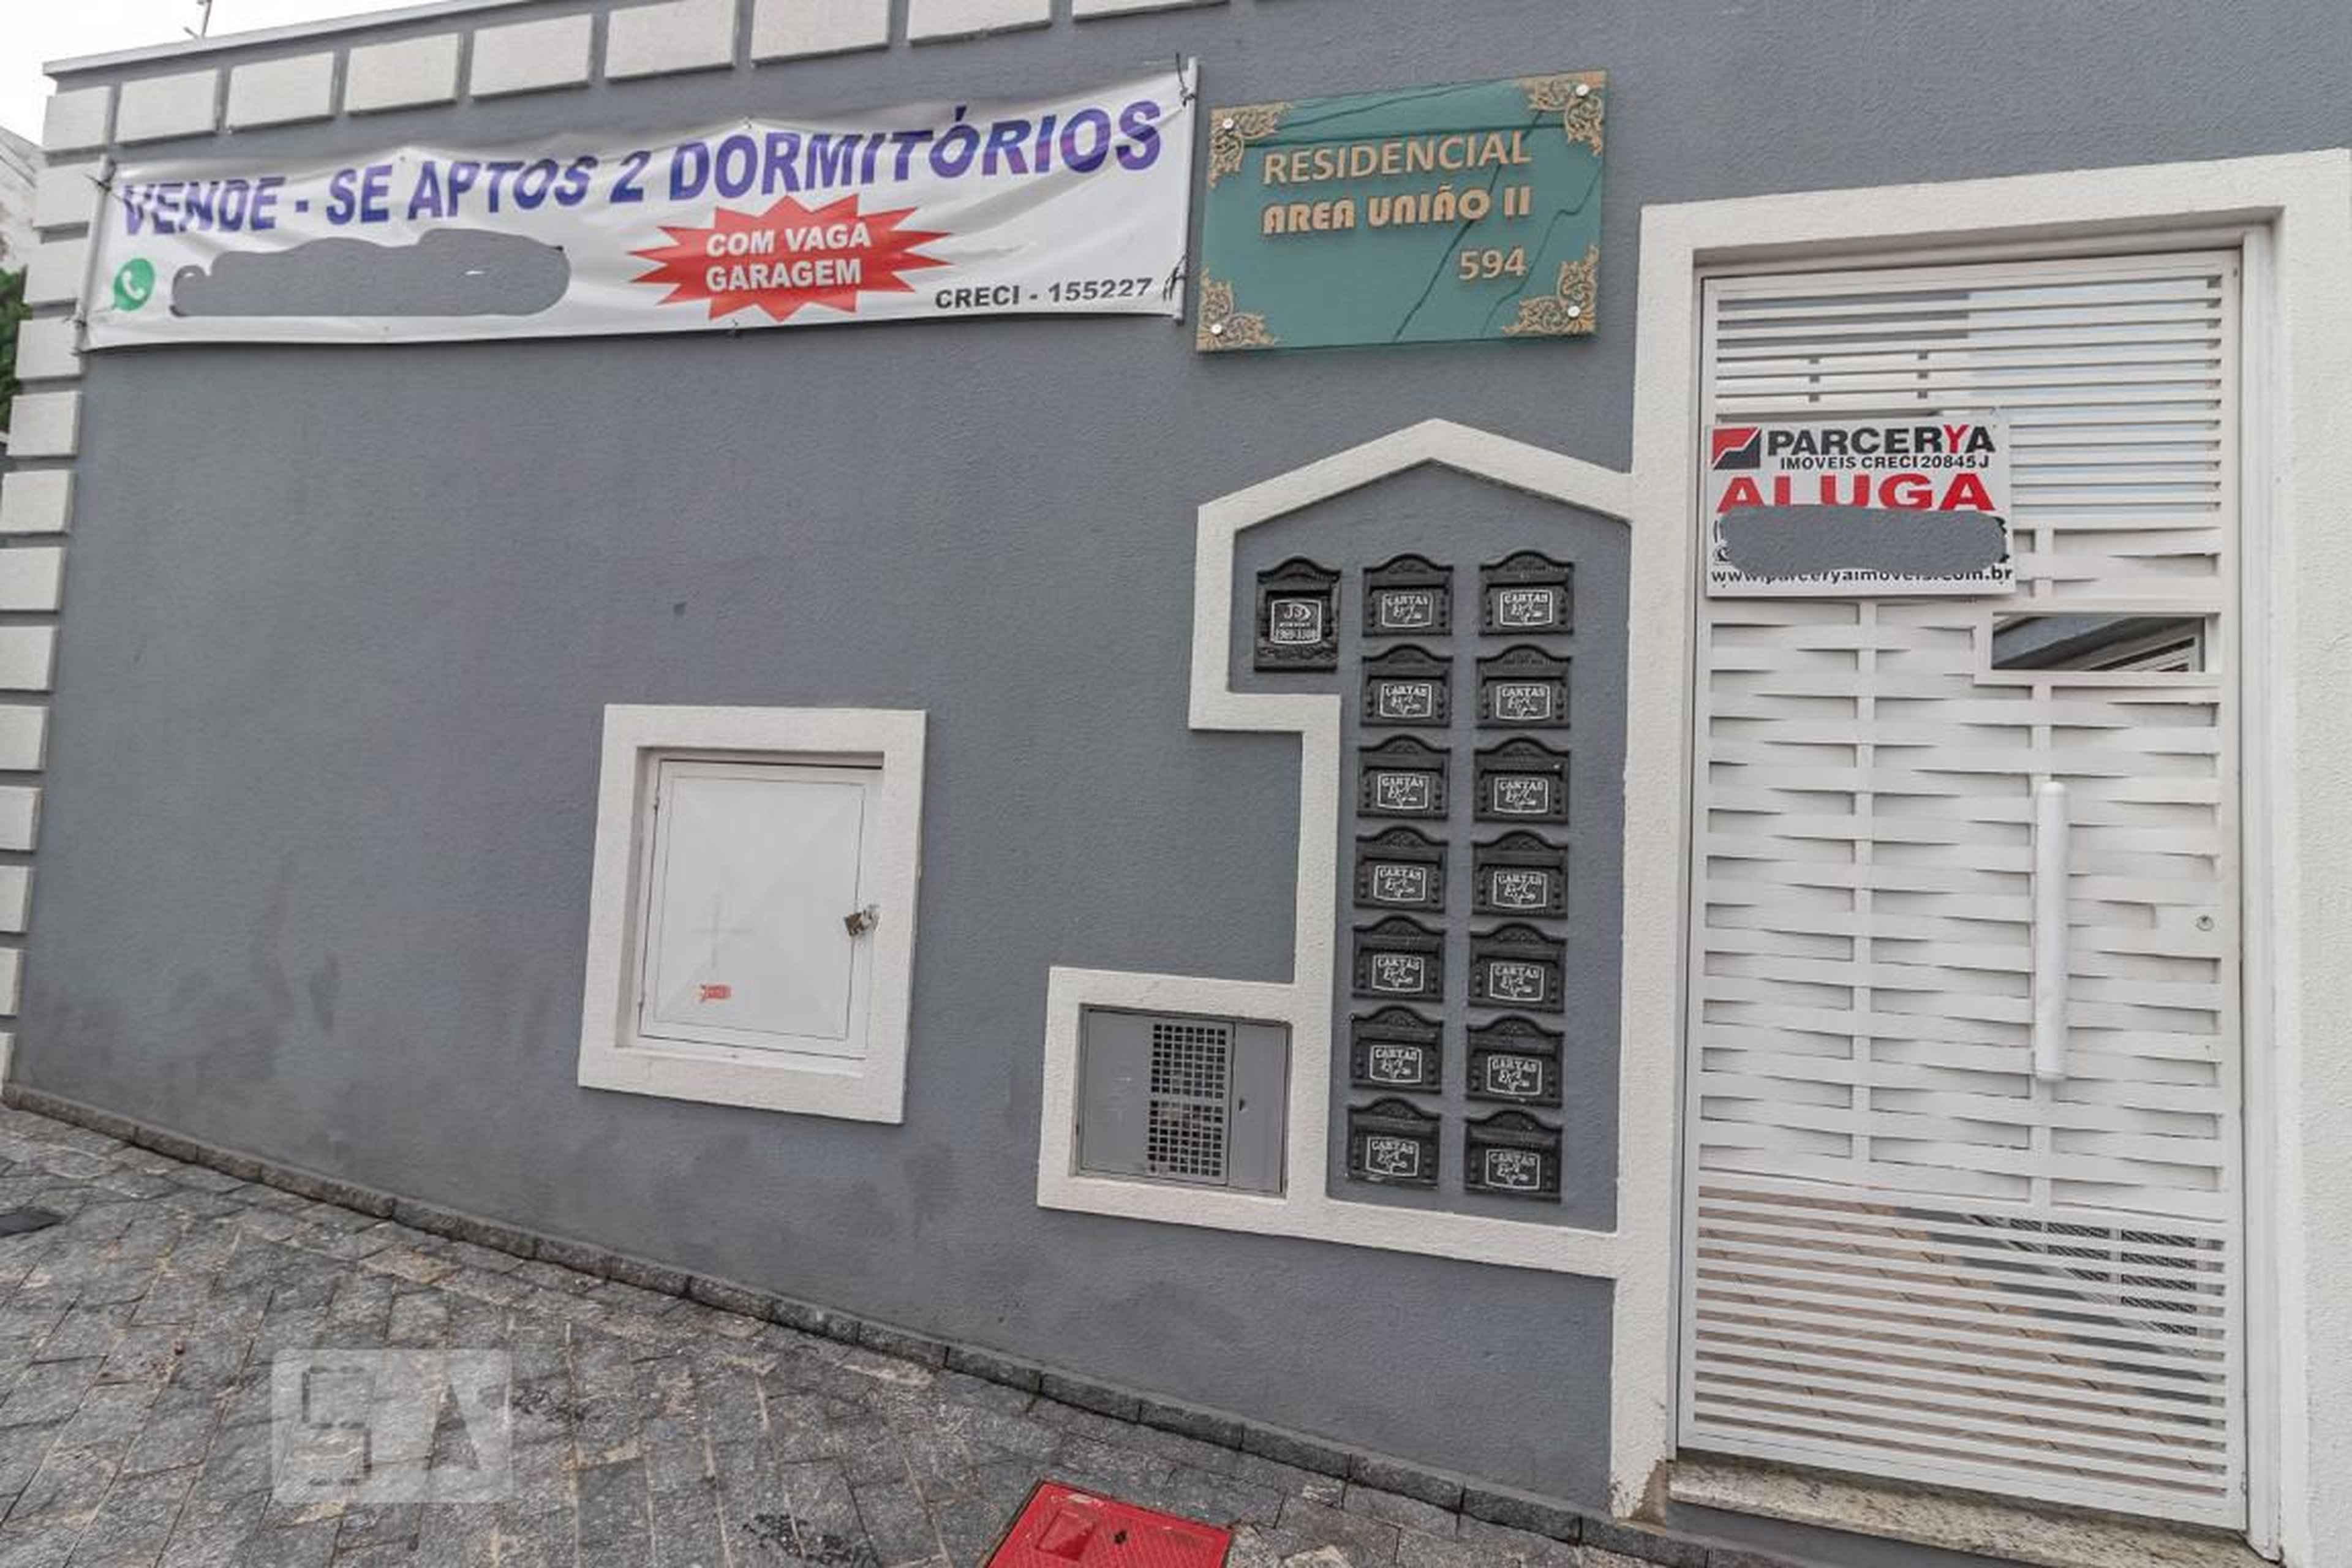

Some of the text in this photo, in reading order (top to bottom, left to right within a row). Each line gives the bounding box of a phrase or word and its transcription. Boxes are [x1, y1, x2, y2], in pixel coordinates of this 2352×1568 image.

[124, 176, 286, 235] VENDE
[326, 165, 393, 225] SE
[407, 156, 599, 220] APTOS
[608, 150, 651, 204] 2
[669, 100, 1161, 202] DORMITÓRIOS
[1264, 131, 1532, 184] RESIDENCIAL
[1263, 184, 1531, 234] AREA UNIÃO II
[706, 222, 871, 257] COM VAGA
[706, 259, 862, 291] GARAGEM
[1459, 247, 1526, 280] 594
[935, 288, 1020, 309] CRECI
[1049, 278, 1153, 303] 155227
[1768, 424, 1996, 456] PARCERYA
[1781, 456, 1856, 470] IMOVEIS
